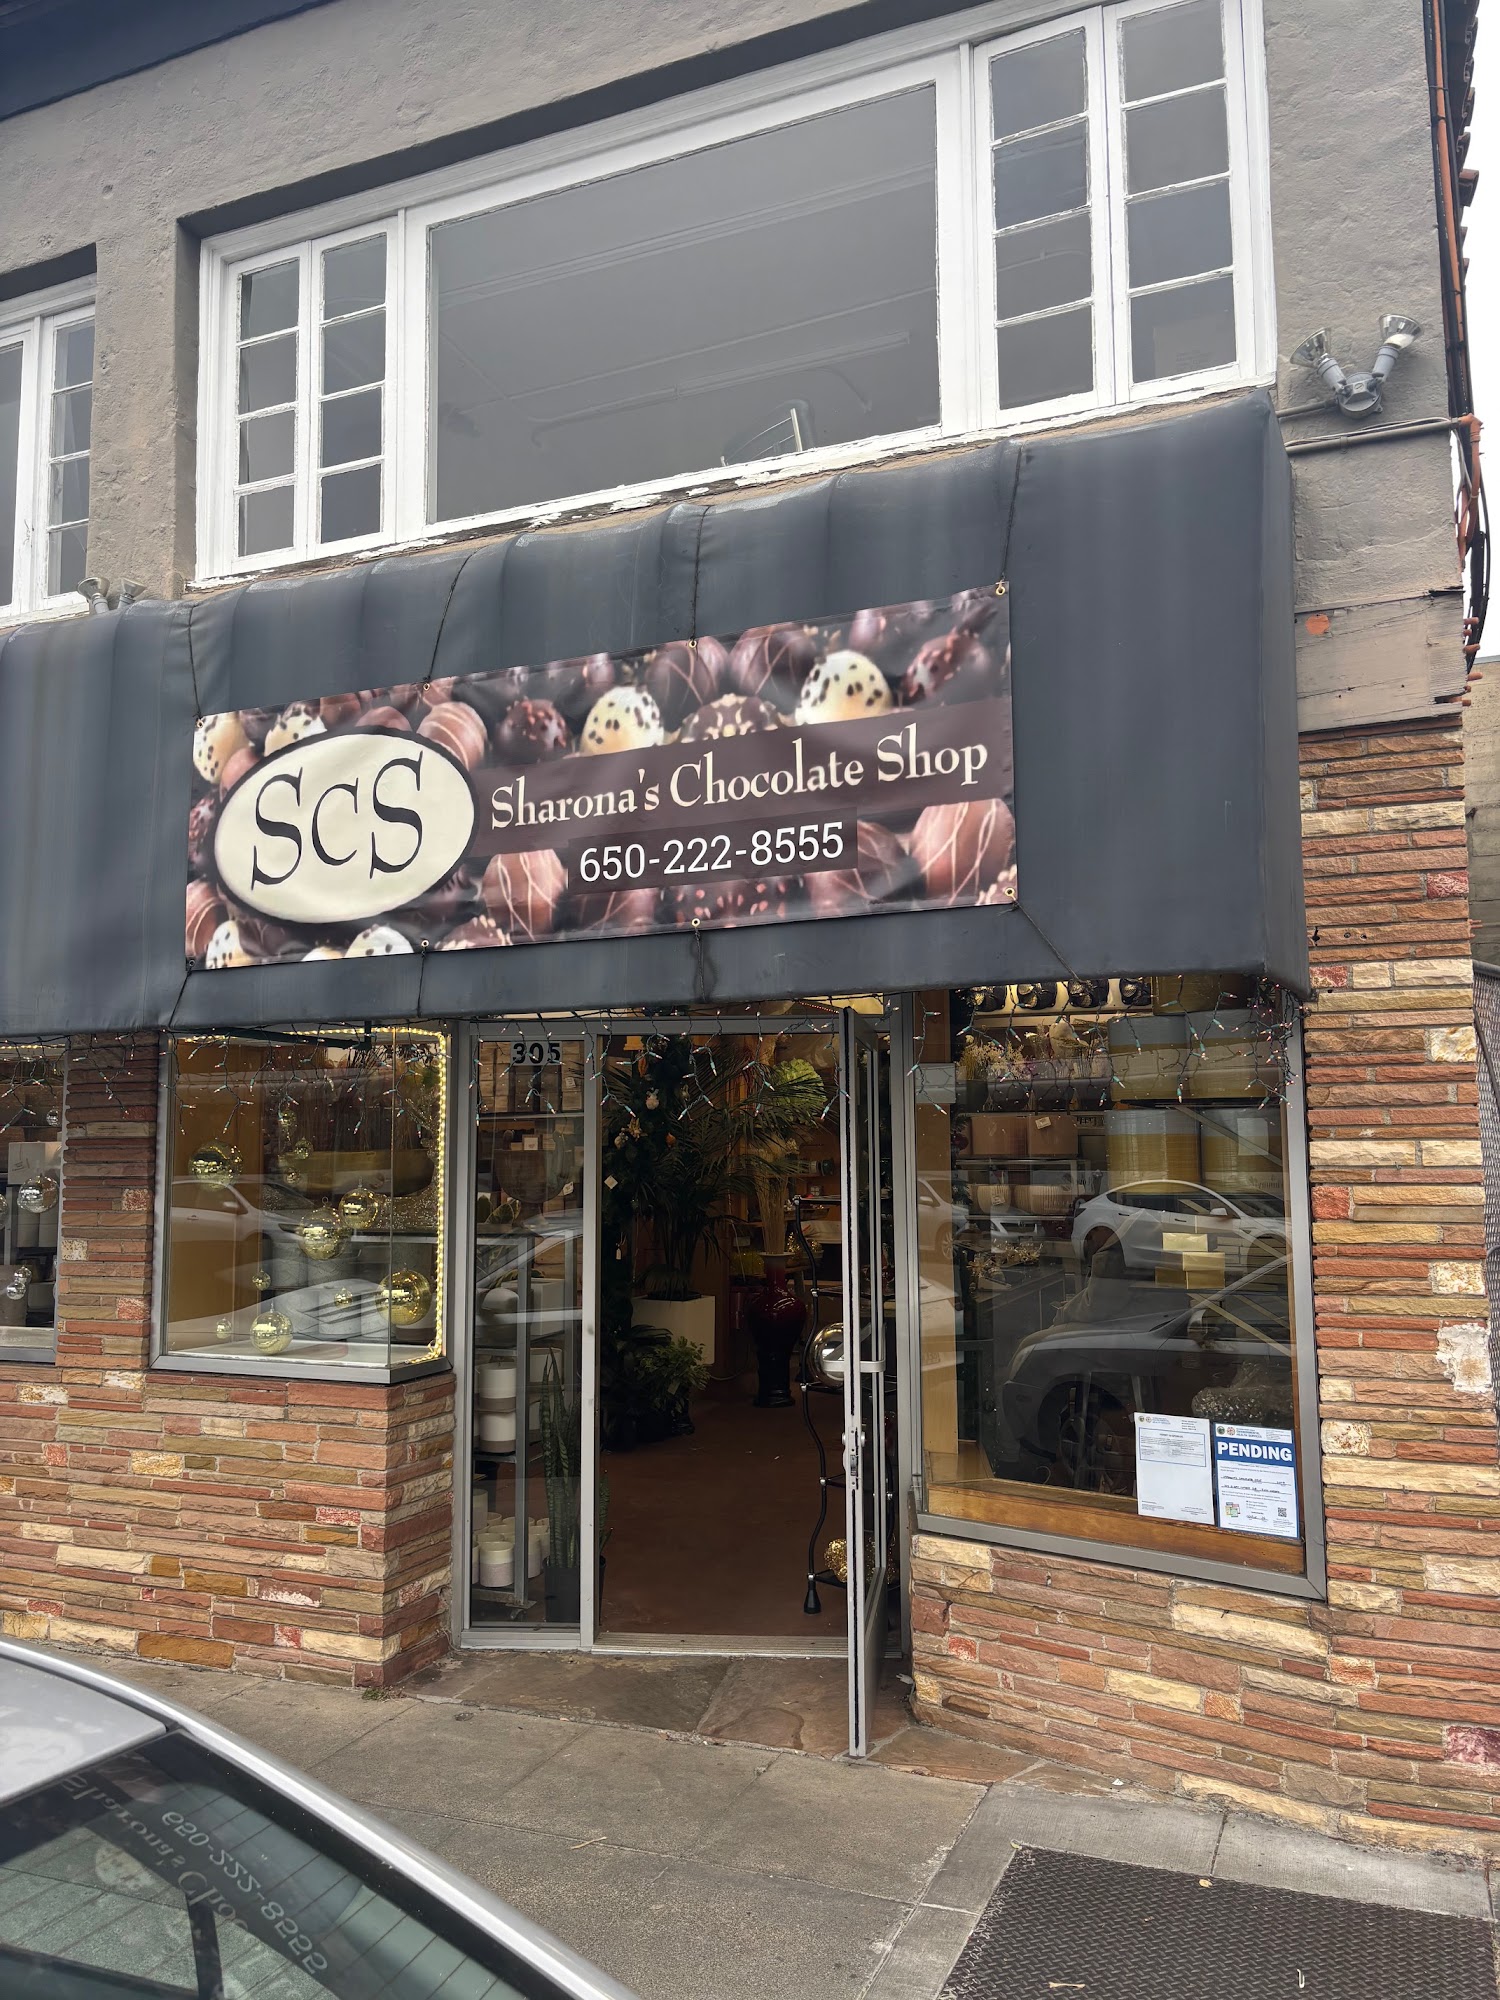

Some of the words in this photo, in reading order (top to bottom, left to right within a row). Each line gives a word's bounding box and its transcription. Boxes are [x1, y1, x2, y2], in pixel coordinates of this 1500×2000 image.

[491, 768, 660, 830] Sharona's
[669, 737, 865, 807] Chocolate
[876, 722, 988, 786] Shop
[251, 750, 424, 891] SCS
[579, 821, 844, 882] 650-222-8555
[512, 1042, 561, 1065] 305
[1217, 1441, 1293, 1462] PENDING
